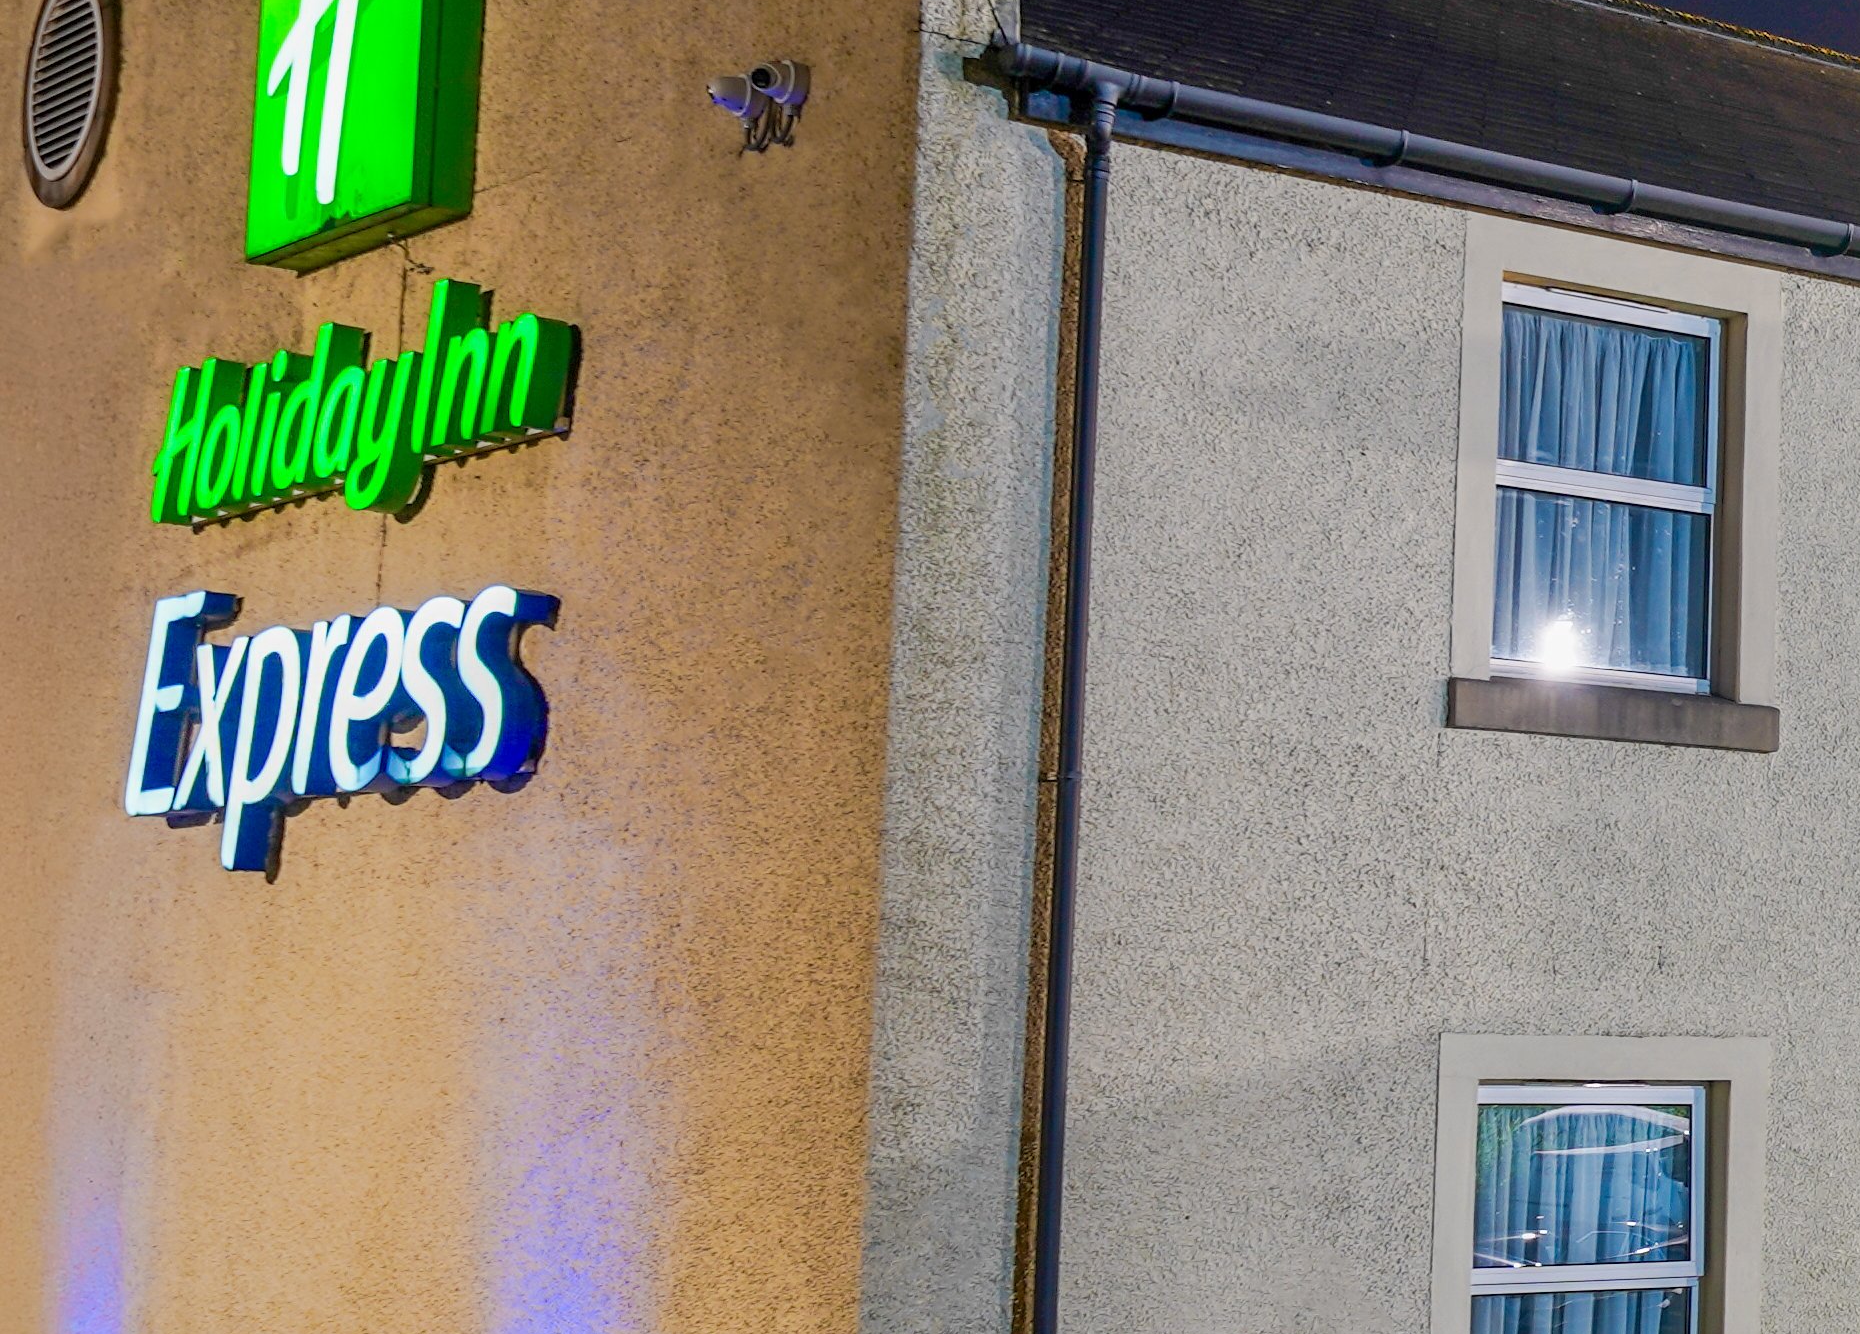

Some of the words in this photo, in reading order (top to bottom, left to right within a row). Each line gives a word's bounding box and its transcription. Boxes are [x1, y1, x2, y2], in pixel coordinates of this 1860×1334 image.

[150, 321, 416, 524] Holiday
[411, 278, 541, 454] Inn
[124, 584, 519, 870] Express
